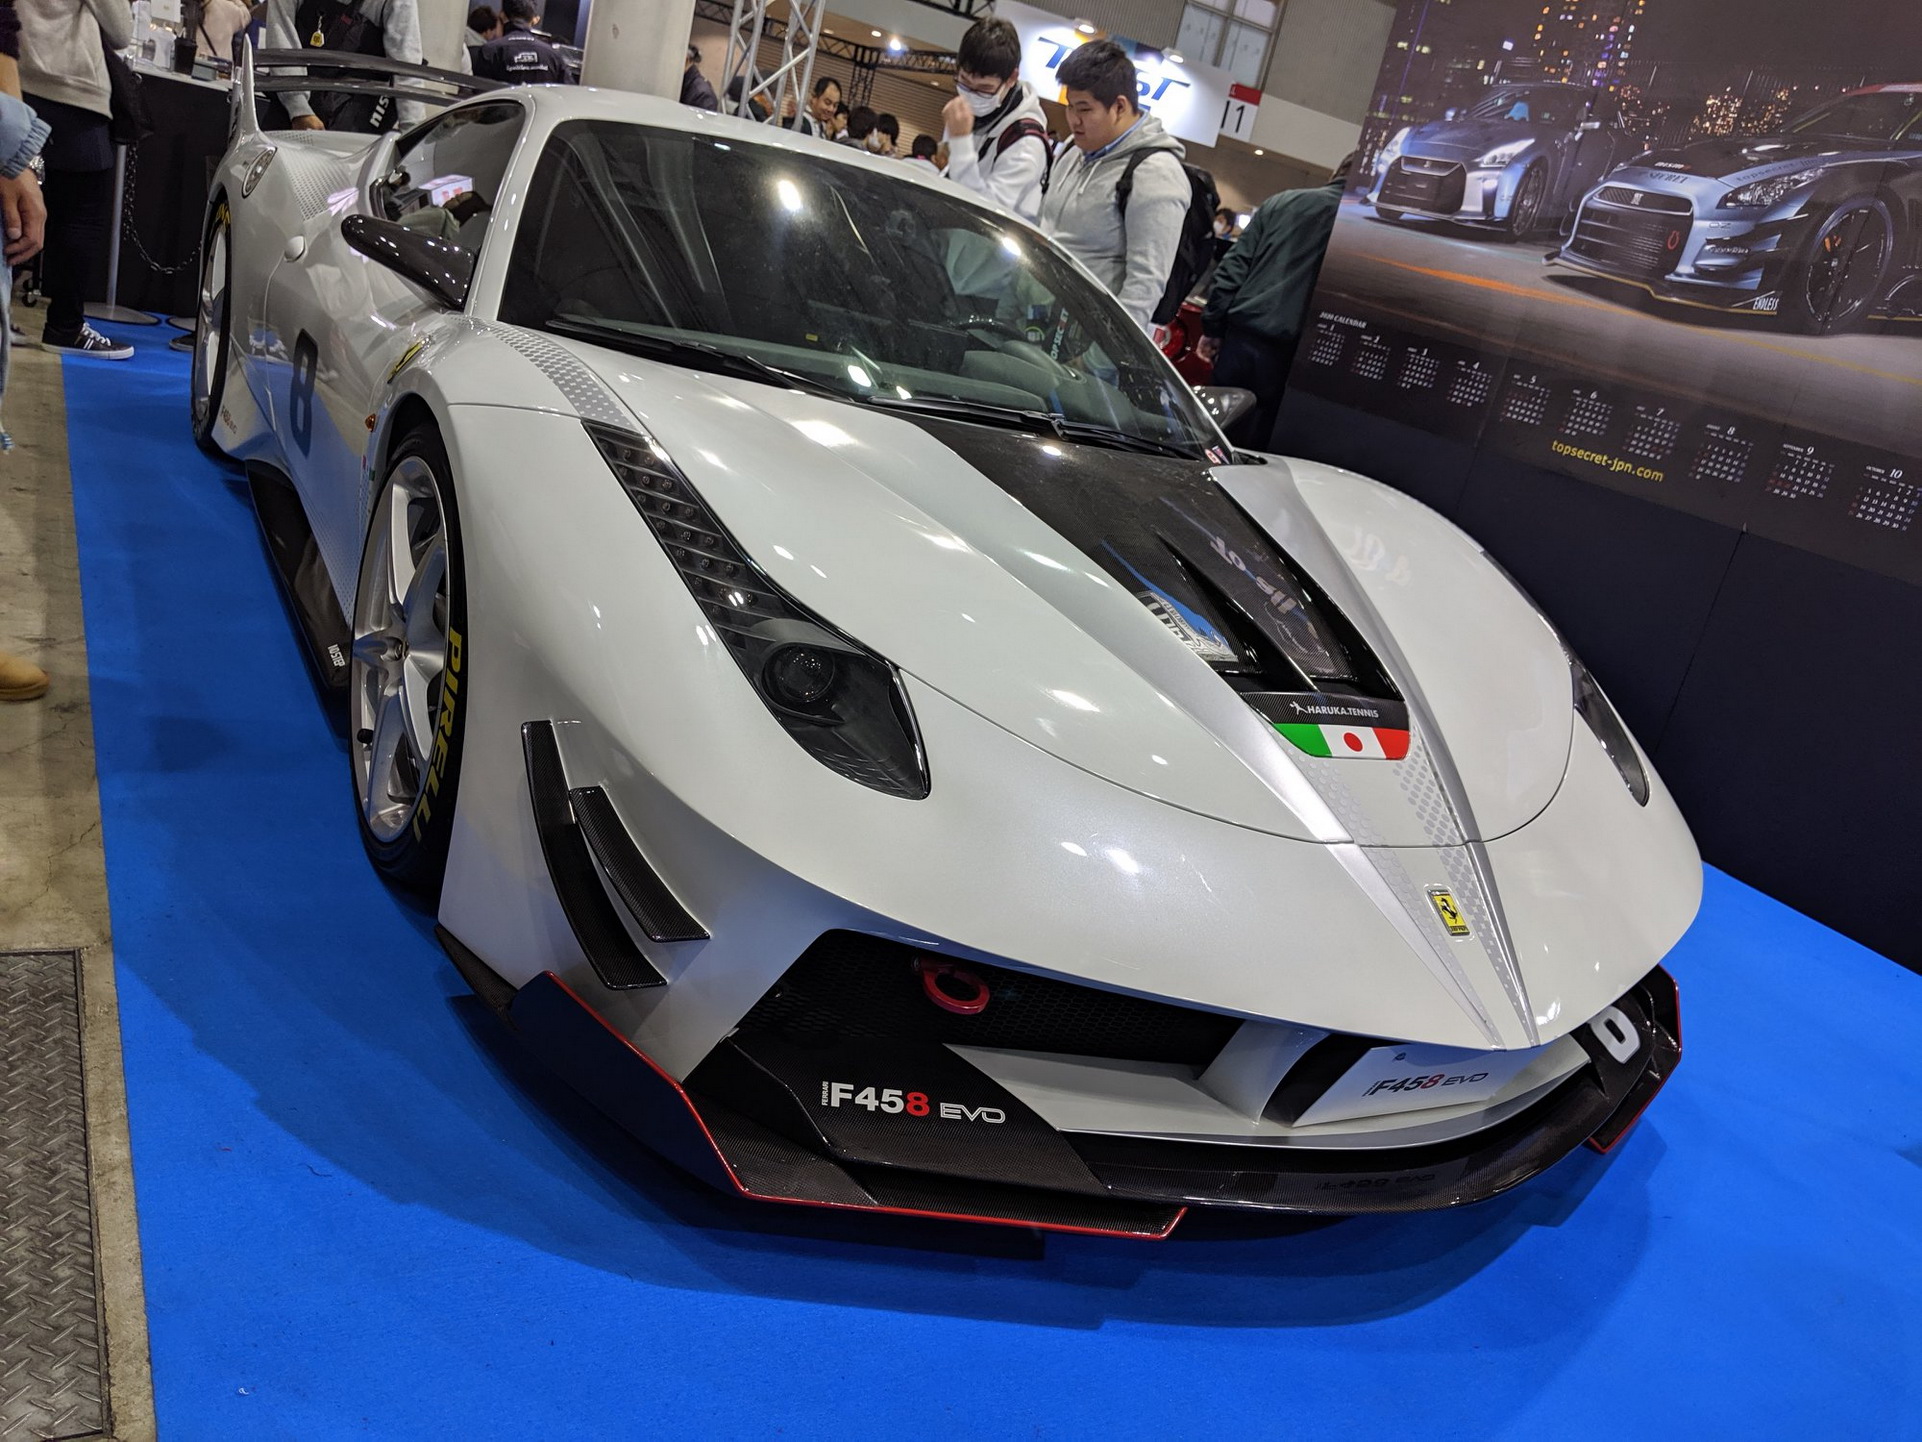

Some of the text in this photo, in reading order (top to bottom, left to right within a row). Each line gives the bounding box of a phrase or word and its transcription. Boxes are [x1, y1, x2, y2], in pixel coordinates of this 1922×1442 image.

[1752, 296, 1779, 311] ENDLESS
[1334, 314, 1368, 329] CALENDAR
[290, 328, 318, 458] 8
[1551, 440, 1664, 482] topsecret-jpn.com
[1890, 468, 1903, 479] 10
[1307, 705, 1379, 718] HARUKA.TENNIS
[412, 626, 462, 843] PIRELLI
[1368, 1074, 1445, 1096] F458
[1441, 1072, 1489, 1086] EVO
[830, 1082, 1006, 1124] F458 EVO
